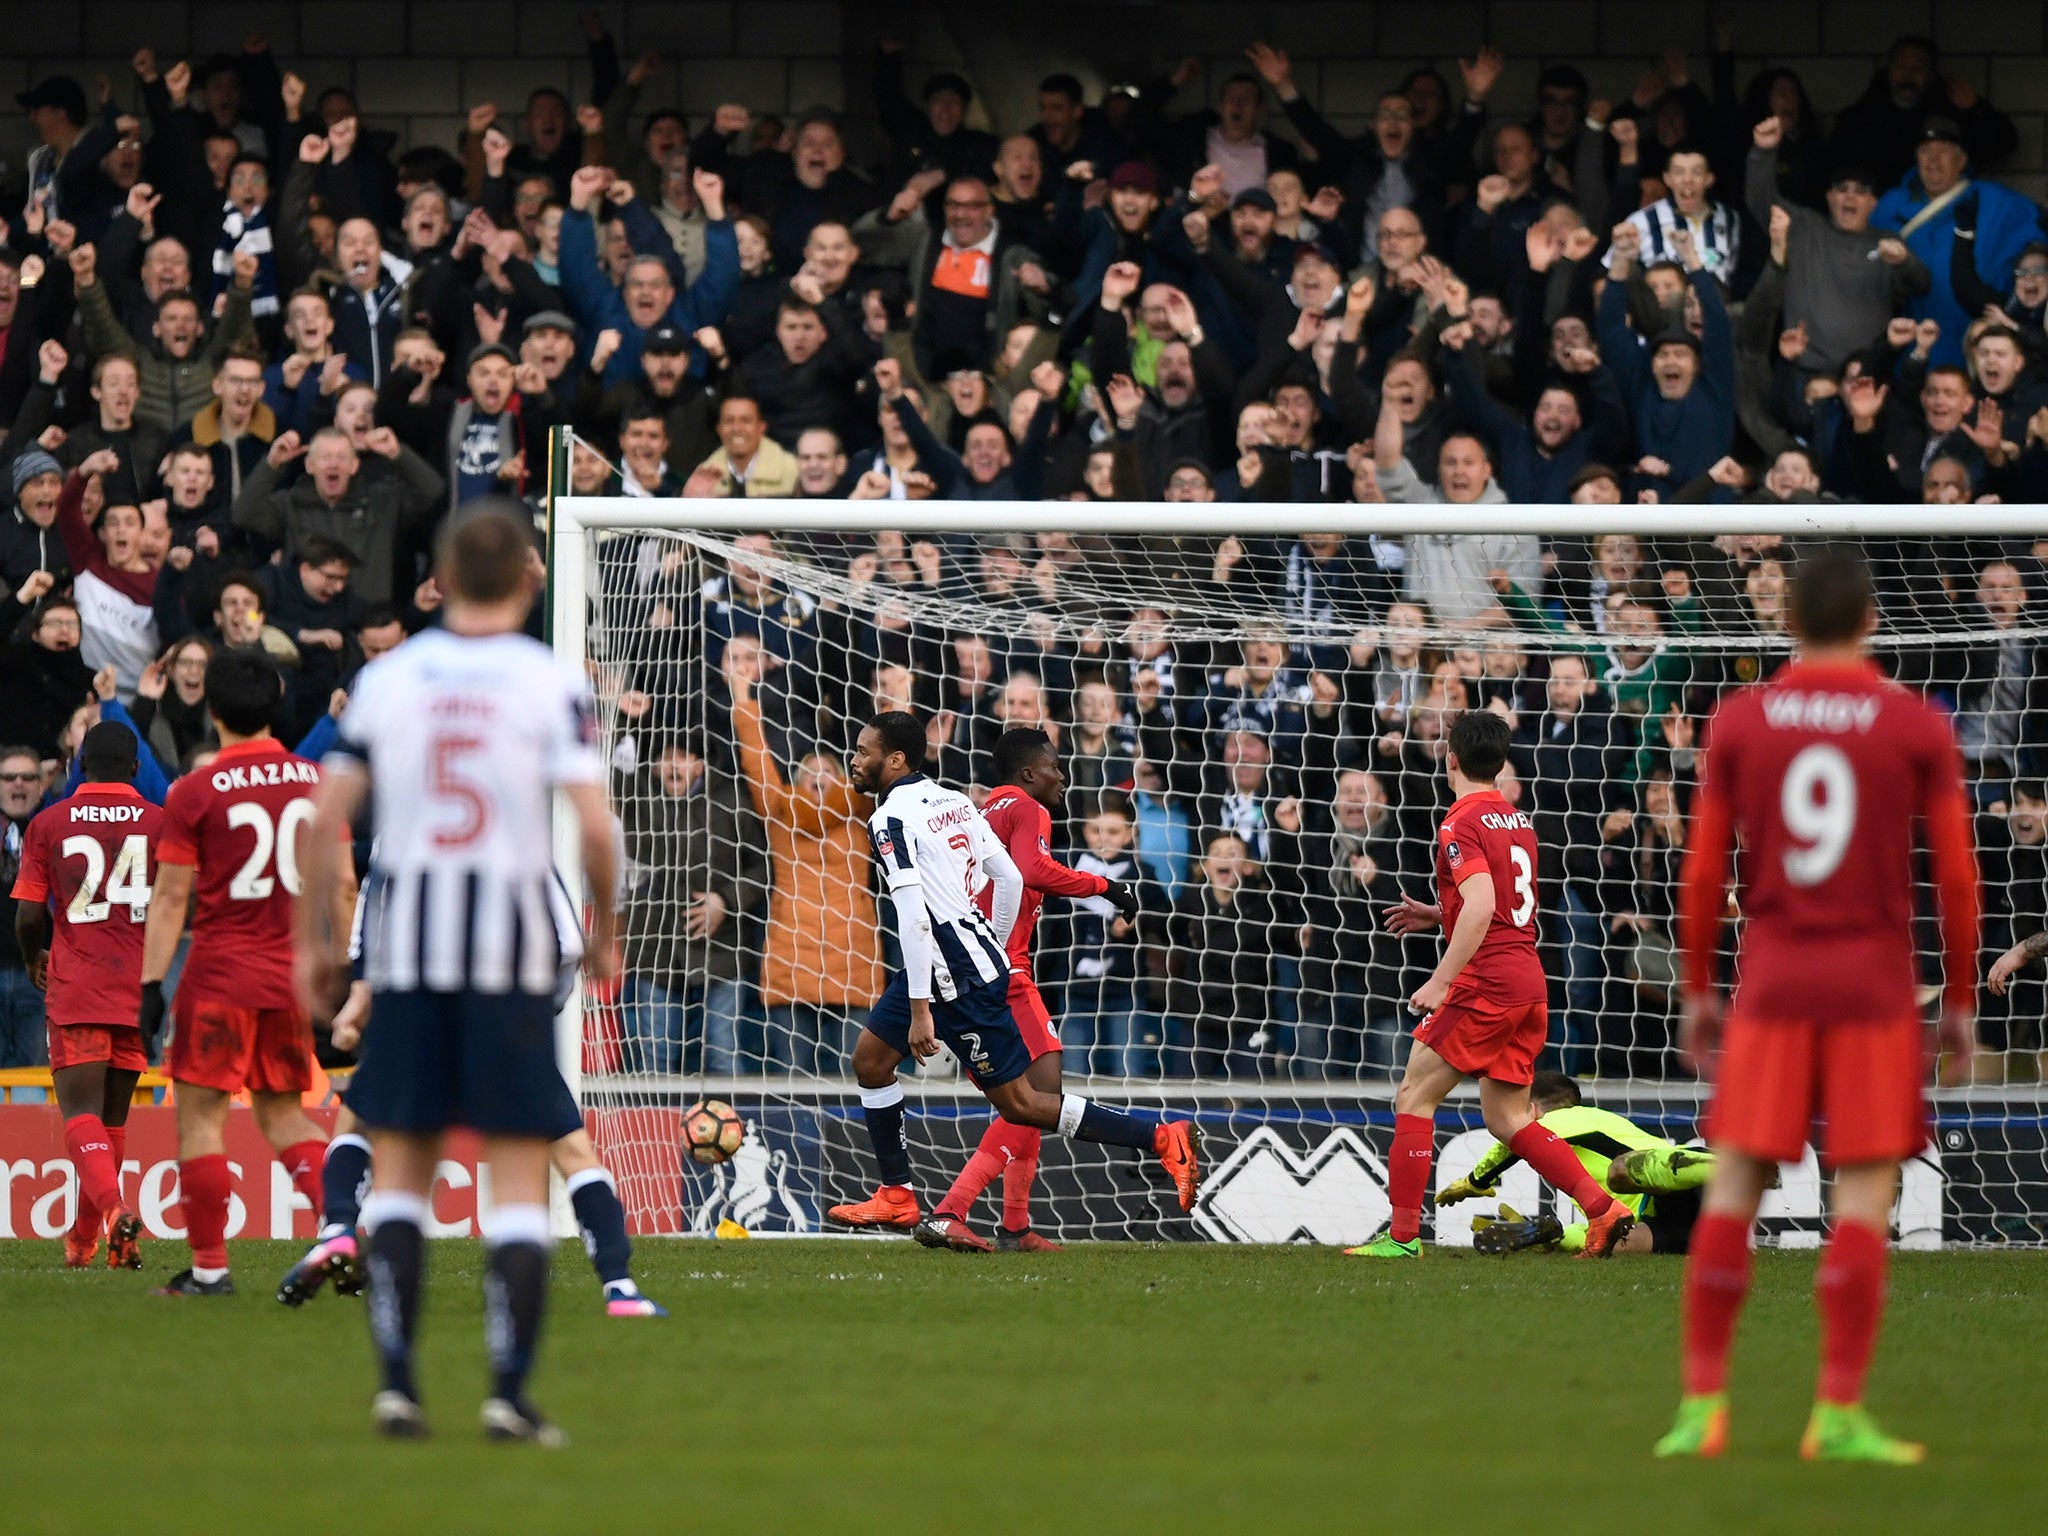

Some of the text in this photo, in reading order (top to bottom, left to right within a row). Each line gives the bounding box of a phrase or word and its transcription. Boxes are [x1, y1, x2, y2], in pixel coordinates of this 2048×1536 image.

[70, 805, 144, 823] MENDY
[211, 761, 319, 793] OKAZAKI
[430, 736, 487, 848] 5
[1781, 744, 1858, 887] 9
[62, 834, 153, 924] 24
[226, 798, 317, 900] 20
[1510, 845, 1535, 927] 3
[960, 1033, 989, 1062] 2
[80, 1142, 109, 1153] LCFC
